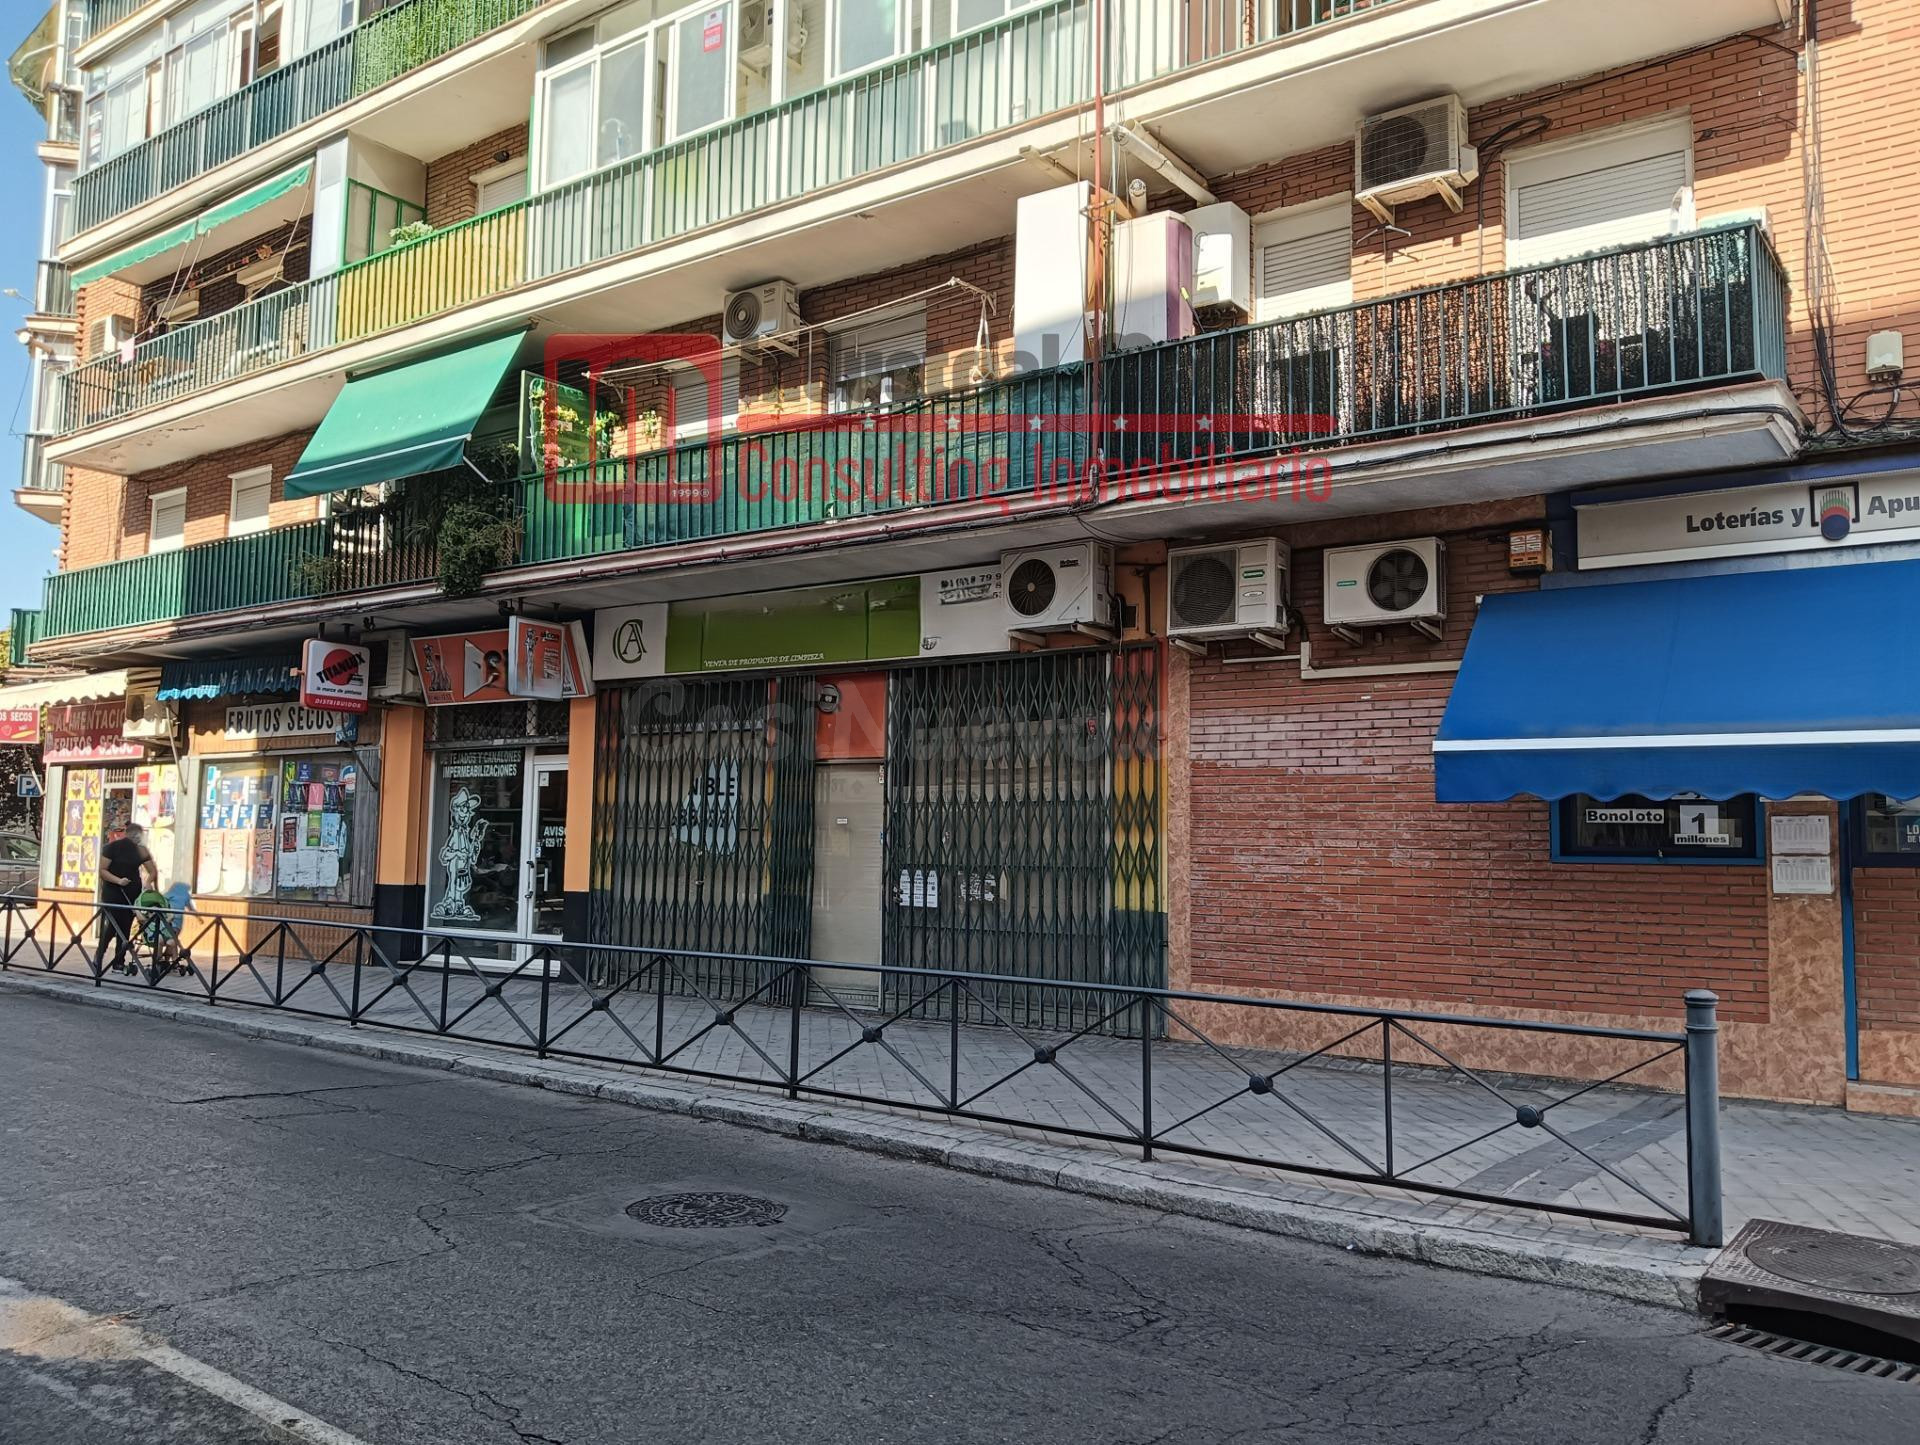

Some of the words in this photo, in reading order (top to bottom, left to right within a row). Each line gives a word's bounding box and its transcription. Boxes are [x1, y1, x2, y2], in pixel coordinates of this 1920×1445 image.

[1687, 507, 1784, 533] Loterías
[1791, 507, 1805, 527] y
[704, 659, 728, 668] VENTA
[739, 656, 778, 666] PRODUCTOS
[779, 655, 789, 663] DE
[789, 652, 825, 662] LIMPIEZA
[314, 698, 362, 708] DISTRIBUIDOR
[10, 712, 33, 722] SECOS
[228, 708, 281, 733] FRUTOS
[288, 706, 334, 731] SECOS
[53, 735, 92, 757] FRUTOS
[450, 751, 476, 764] TEJADOS
[484, 750, 521, 763] CANALONES
[442, 764, 517, 778] IMPERMEABILIZACIONES
[22, 778, 36, 794] P
[1587, 810, 1663, 822] Bonoloto
[1691, 812, 1705, 834] 1
[1676, 835, 1727, 843] millones
